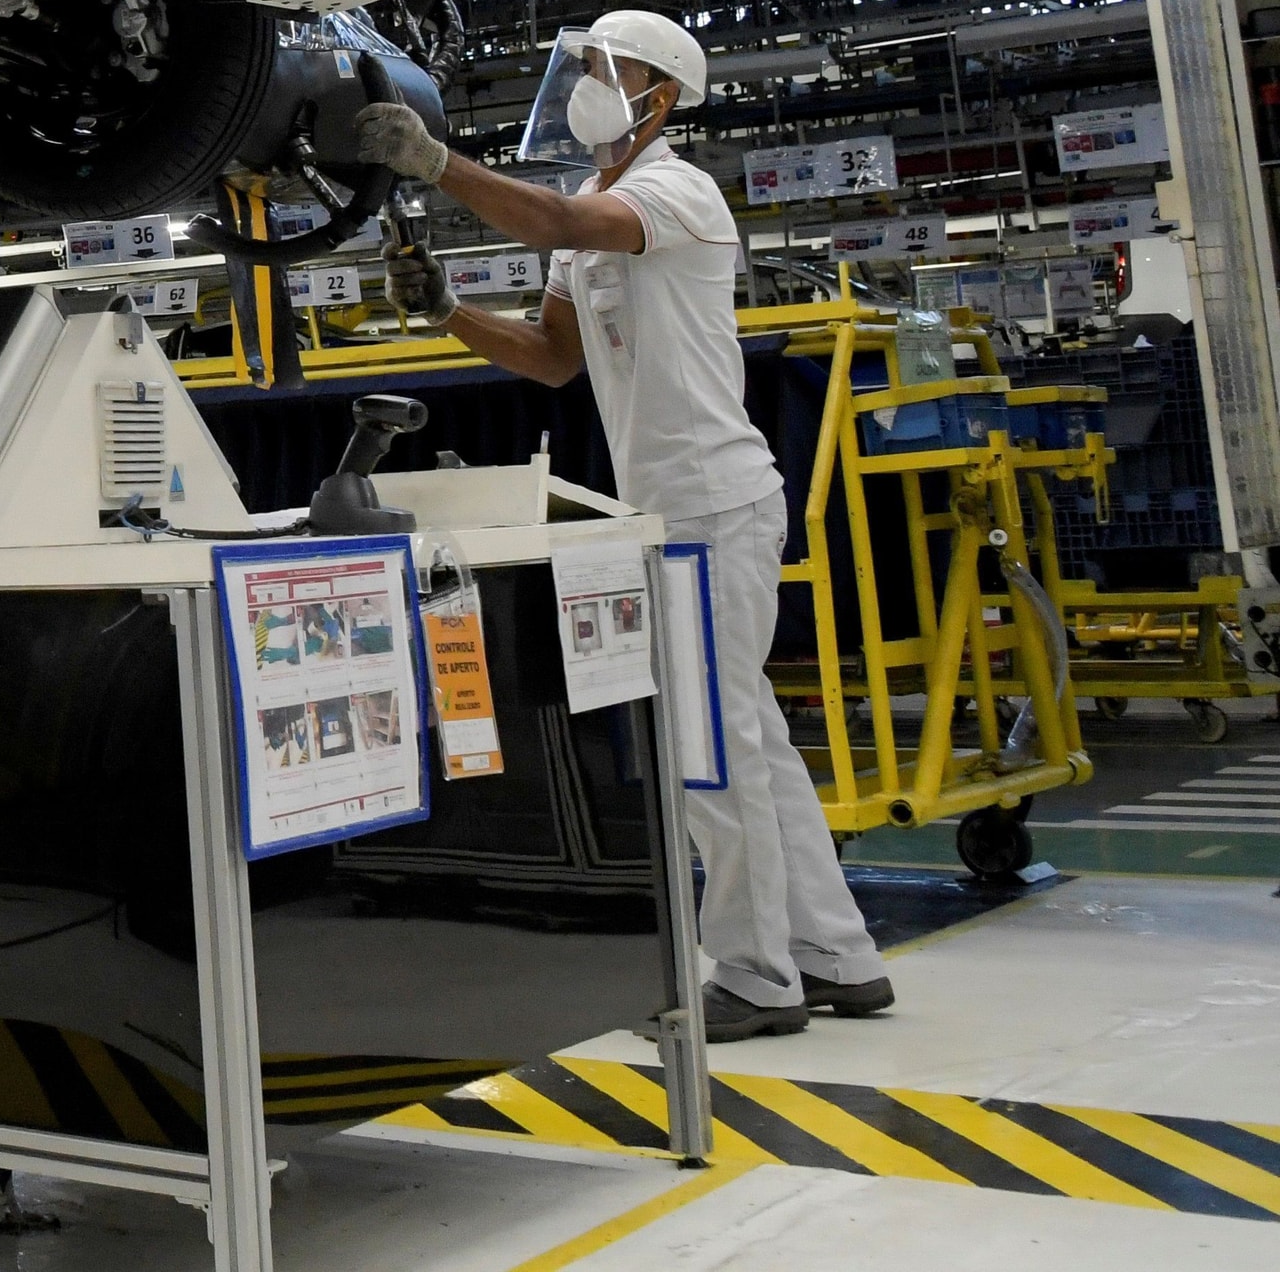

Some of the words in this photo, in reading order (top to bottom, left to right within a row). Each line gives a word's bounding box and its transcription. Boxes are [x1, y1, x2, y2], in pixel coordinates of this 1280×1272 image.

[841, 148, 872, 172] 32
[132, 226, 155, 245] 36
[904, 226, 929, 241] 48
[507, 261, 527, 276] 56
[327, 275, 346, 290] 22
[169, 287, 186, 301] 62
[440, 616, 466, 629] FCA
[435, 641, 476, 655] CONTROLE
[437, 663, 449, 675] DE
[450, 660, 480, 674] APERTO
